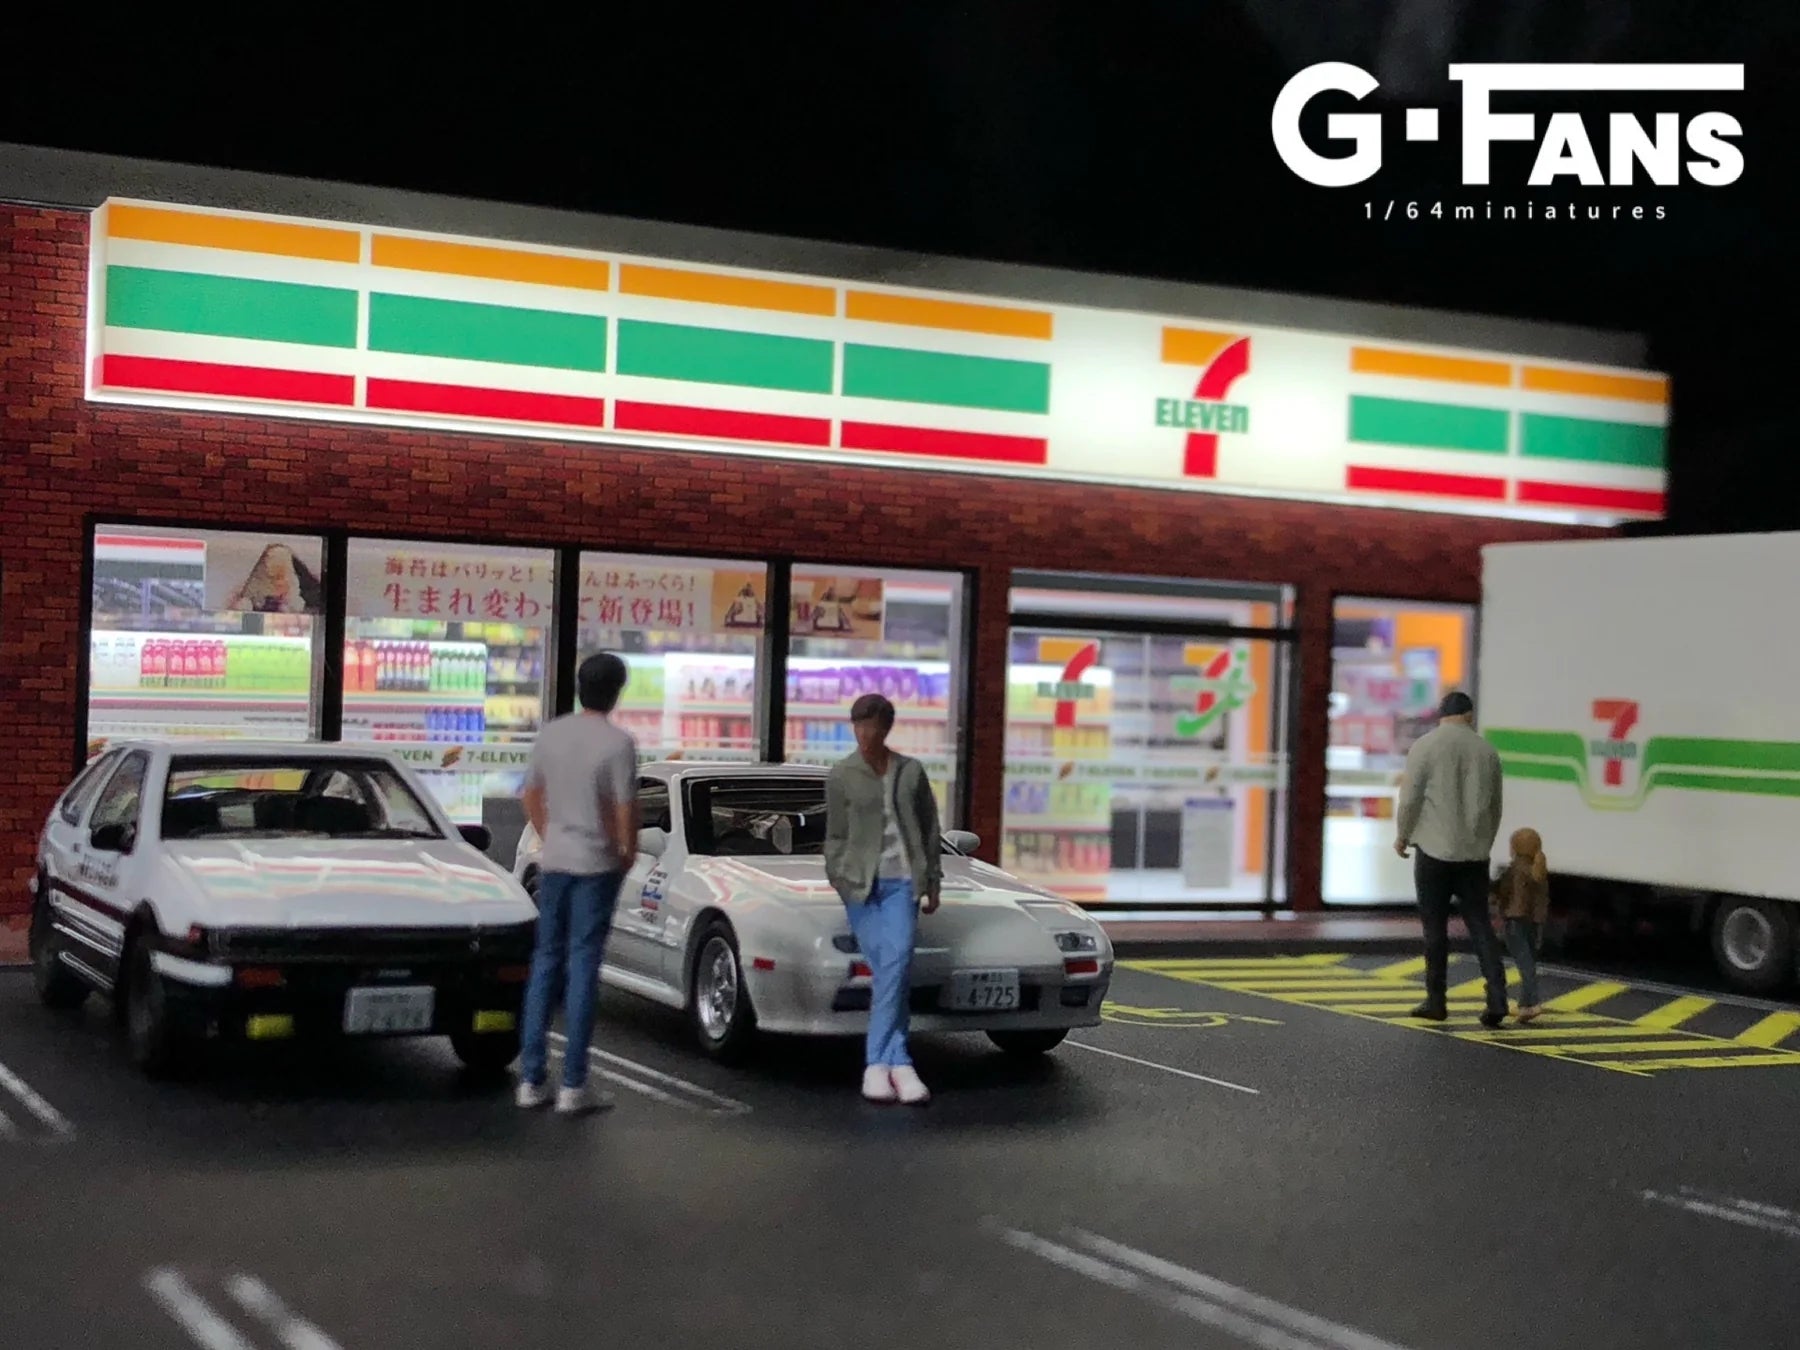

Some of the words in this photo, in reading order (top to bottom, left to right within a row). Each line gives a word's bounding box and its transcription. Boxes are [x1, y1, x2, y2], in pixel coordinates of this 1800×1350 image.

[1160, 325, 1252, 478] 7
[467, 751, 530, 763] 7-ELEVE
[1592, 698, 1638, 786] 7
